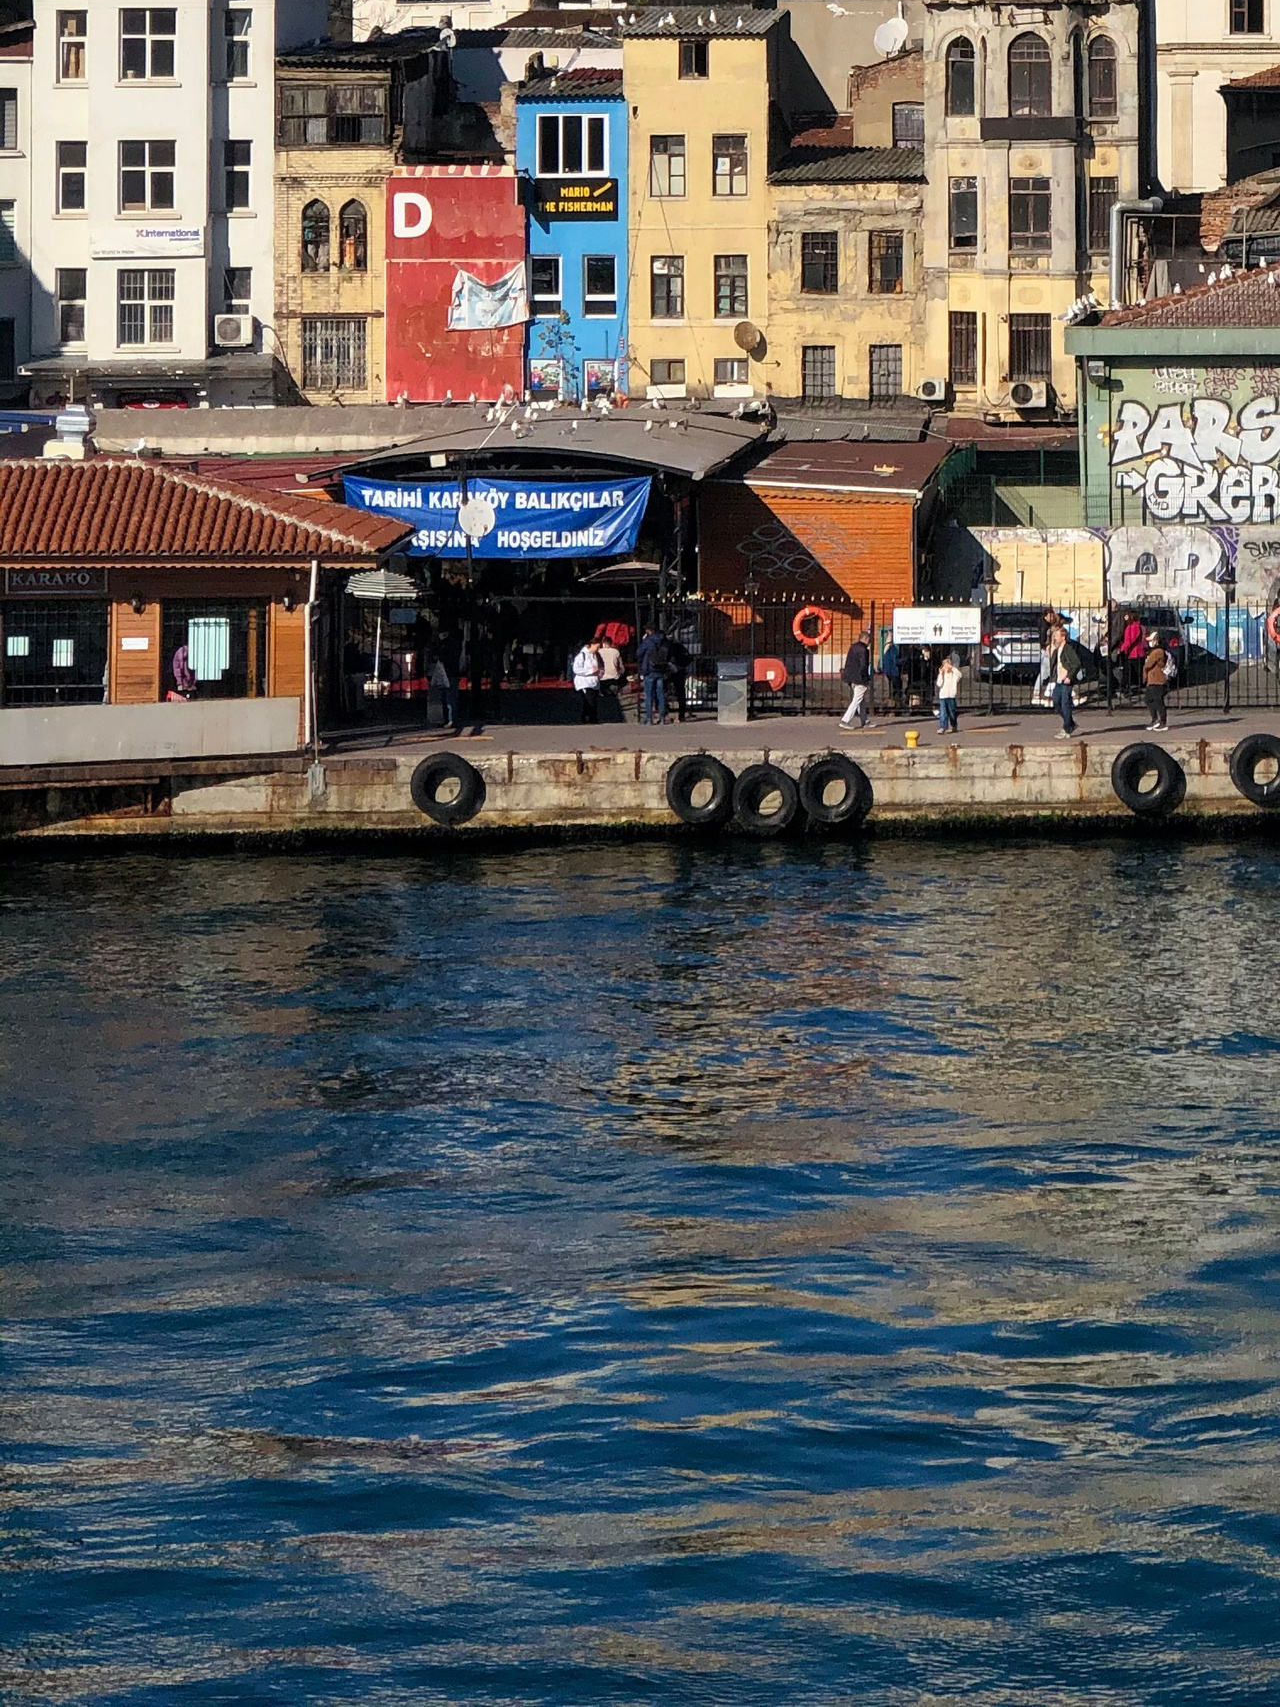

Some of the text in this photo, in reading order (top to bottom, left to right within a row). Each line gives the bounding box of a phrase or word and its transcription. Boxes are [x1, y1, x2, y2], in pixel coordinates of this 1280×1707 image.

[560, 187, 590, 197] MARIO
[538, 201, 614, 212] THE FISHERMAN
[394, 193, 432, 238] D
[361, 488, 423, 509] TARİHİ
[514, 490, 625, 511] BALIKÇILAR
